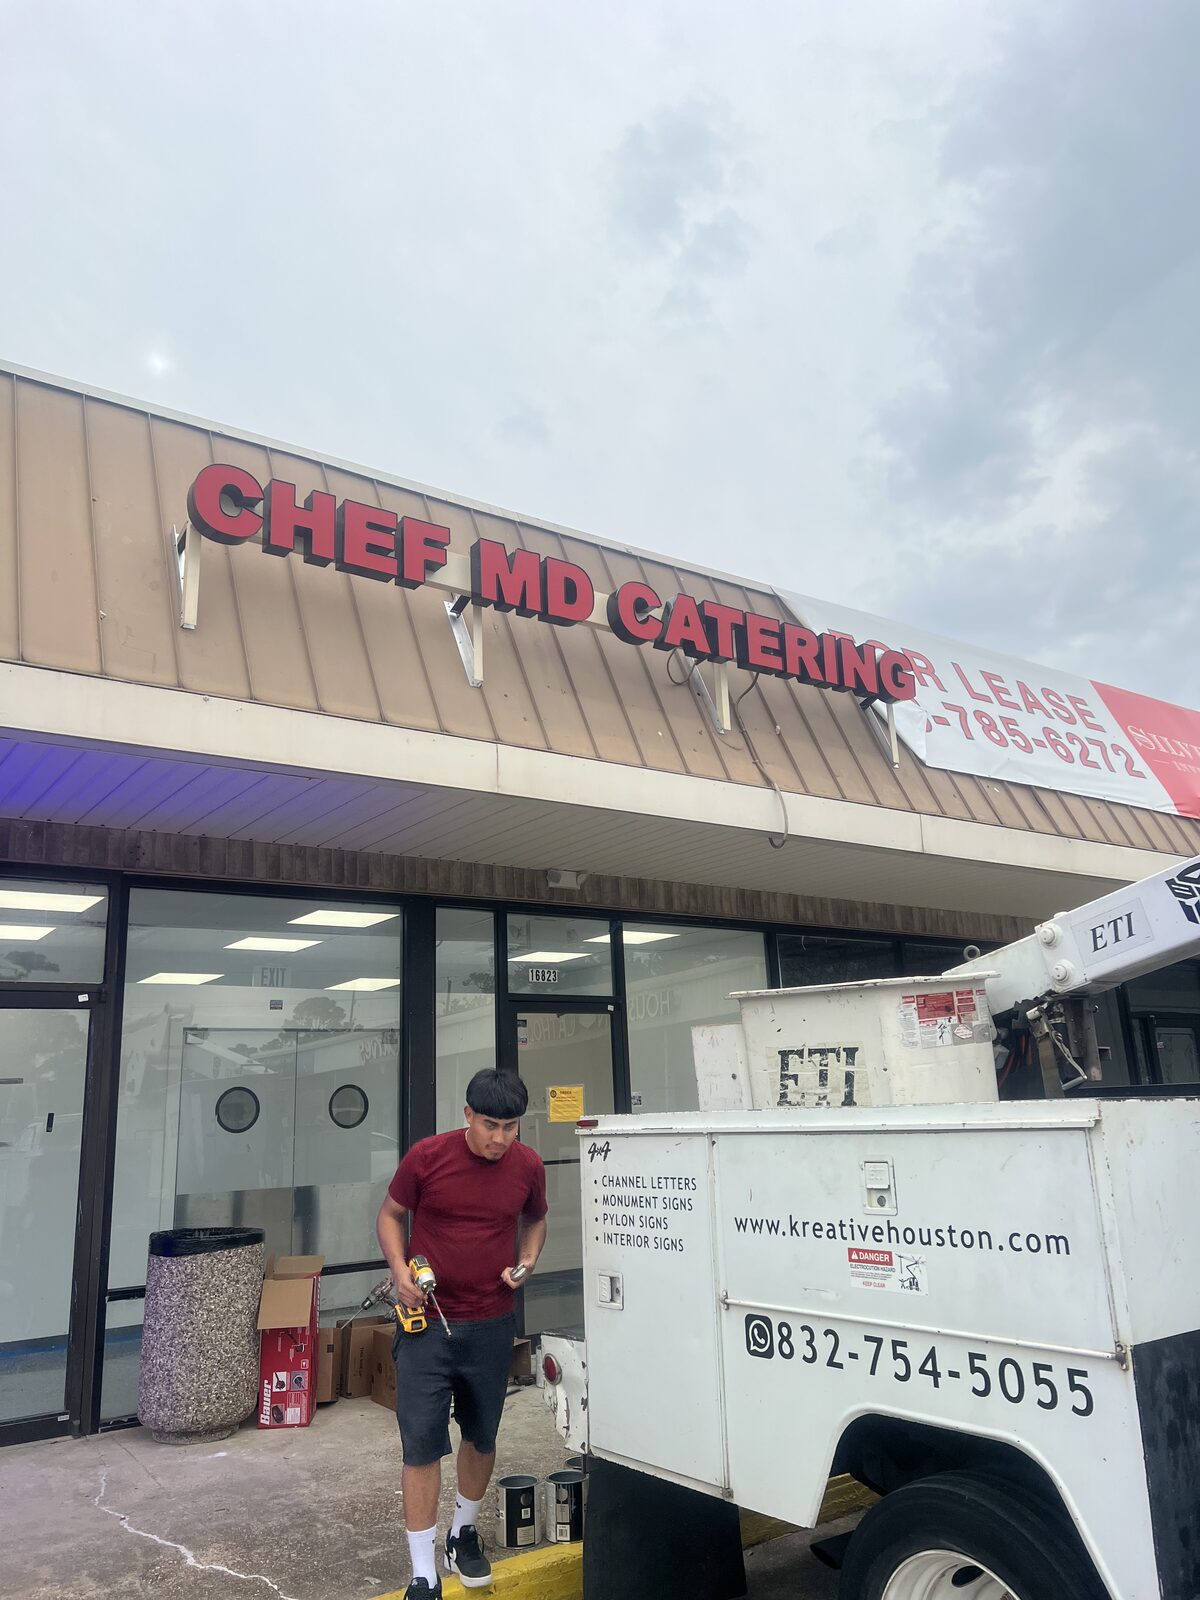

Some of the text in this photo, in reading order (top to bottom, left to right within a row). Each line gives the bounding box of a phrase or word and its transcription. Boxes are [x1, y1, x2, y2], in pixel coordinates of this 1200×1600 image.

[187, 463, 451, 590] CHEF
[471, 537, 595, 627] MD
[607, 581, 916, 704] CATERING
[951, 661, 1107, 733] LEASE
[925, 701, 1148, 779] -785-6272
[1090, 911, 1137, 952] ETI
[261, 966, 287, 988] EXIT
[530, 969, 557, 983] 16823
[777, 1046, 860, 1107] ETI
[602, 1175, 697, 1191] CHANNEL LETTERS
[602, 1194, 693, 1211] MONUMENT SIGNS
[603, 1213, 668, 1230] PYLON SIGNS
[603, 1232, 684, 1252] INTERIOR SIGNS
[735, 1215, 1071, 1256] www.kreativehouston.com
[859, 1251, 890, 1263] DANGER
[778, 1321, 1094, 1417] 832-754-5055
[260, 1380, 272, 1426] Bauer
